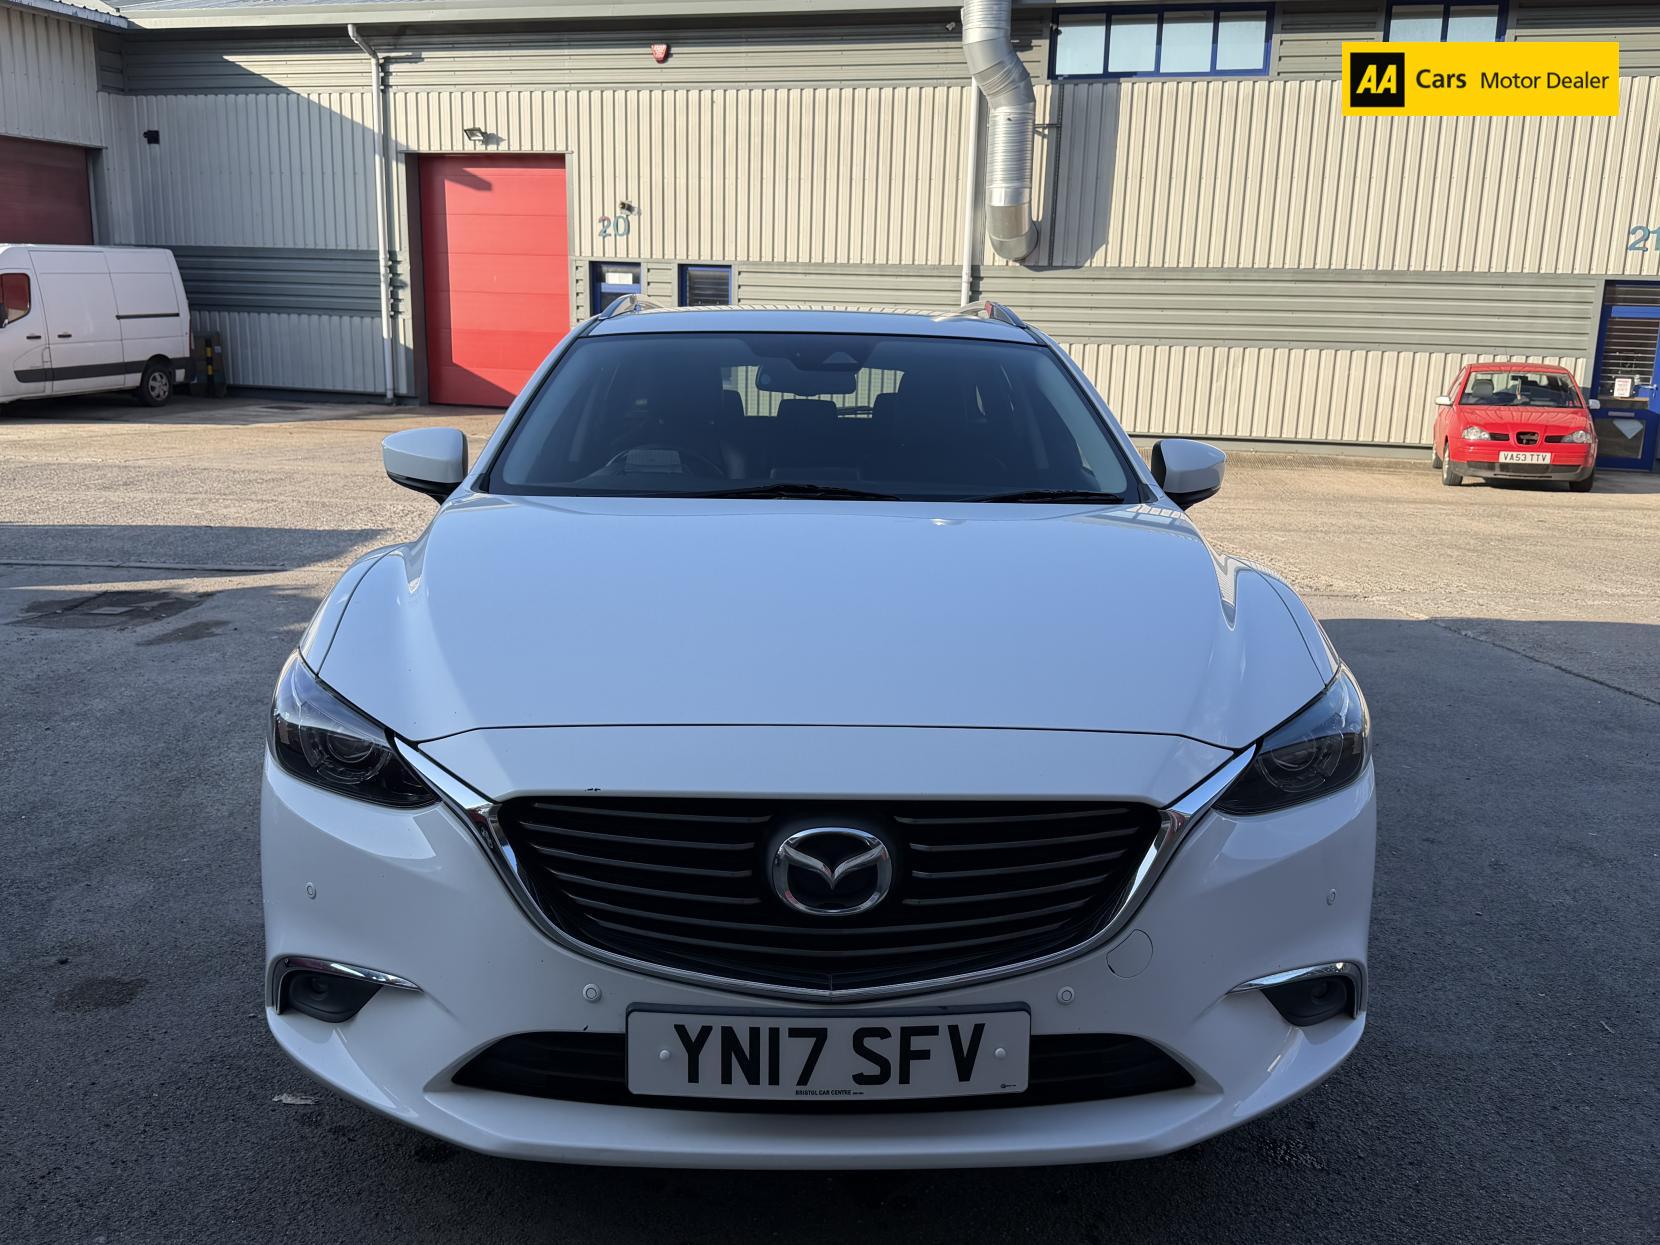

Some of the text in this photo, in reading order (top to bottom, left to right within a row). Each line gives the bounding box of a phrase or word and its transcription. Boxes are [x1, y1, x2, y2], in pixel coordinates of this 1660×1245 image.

[598, 215, 630, 239] 20
[1503, 453, 1547, 462] VA53 TTV
[674, 1023, 986, 1086] YN17 SFV
